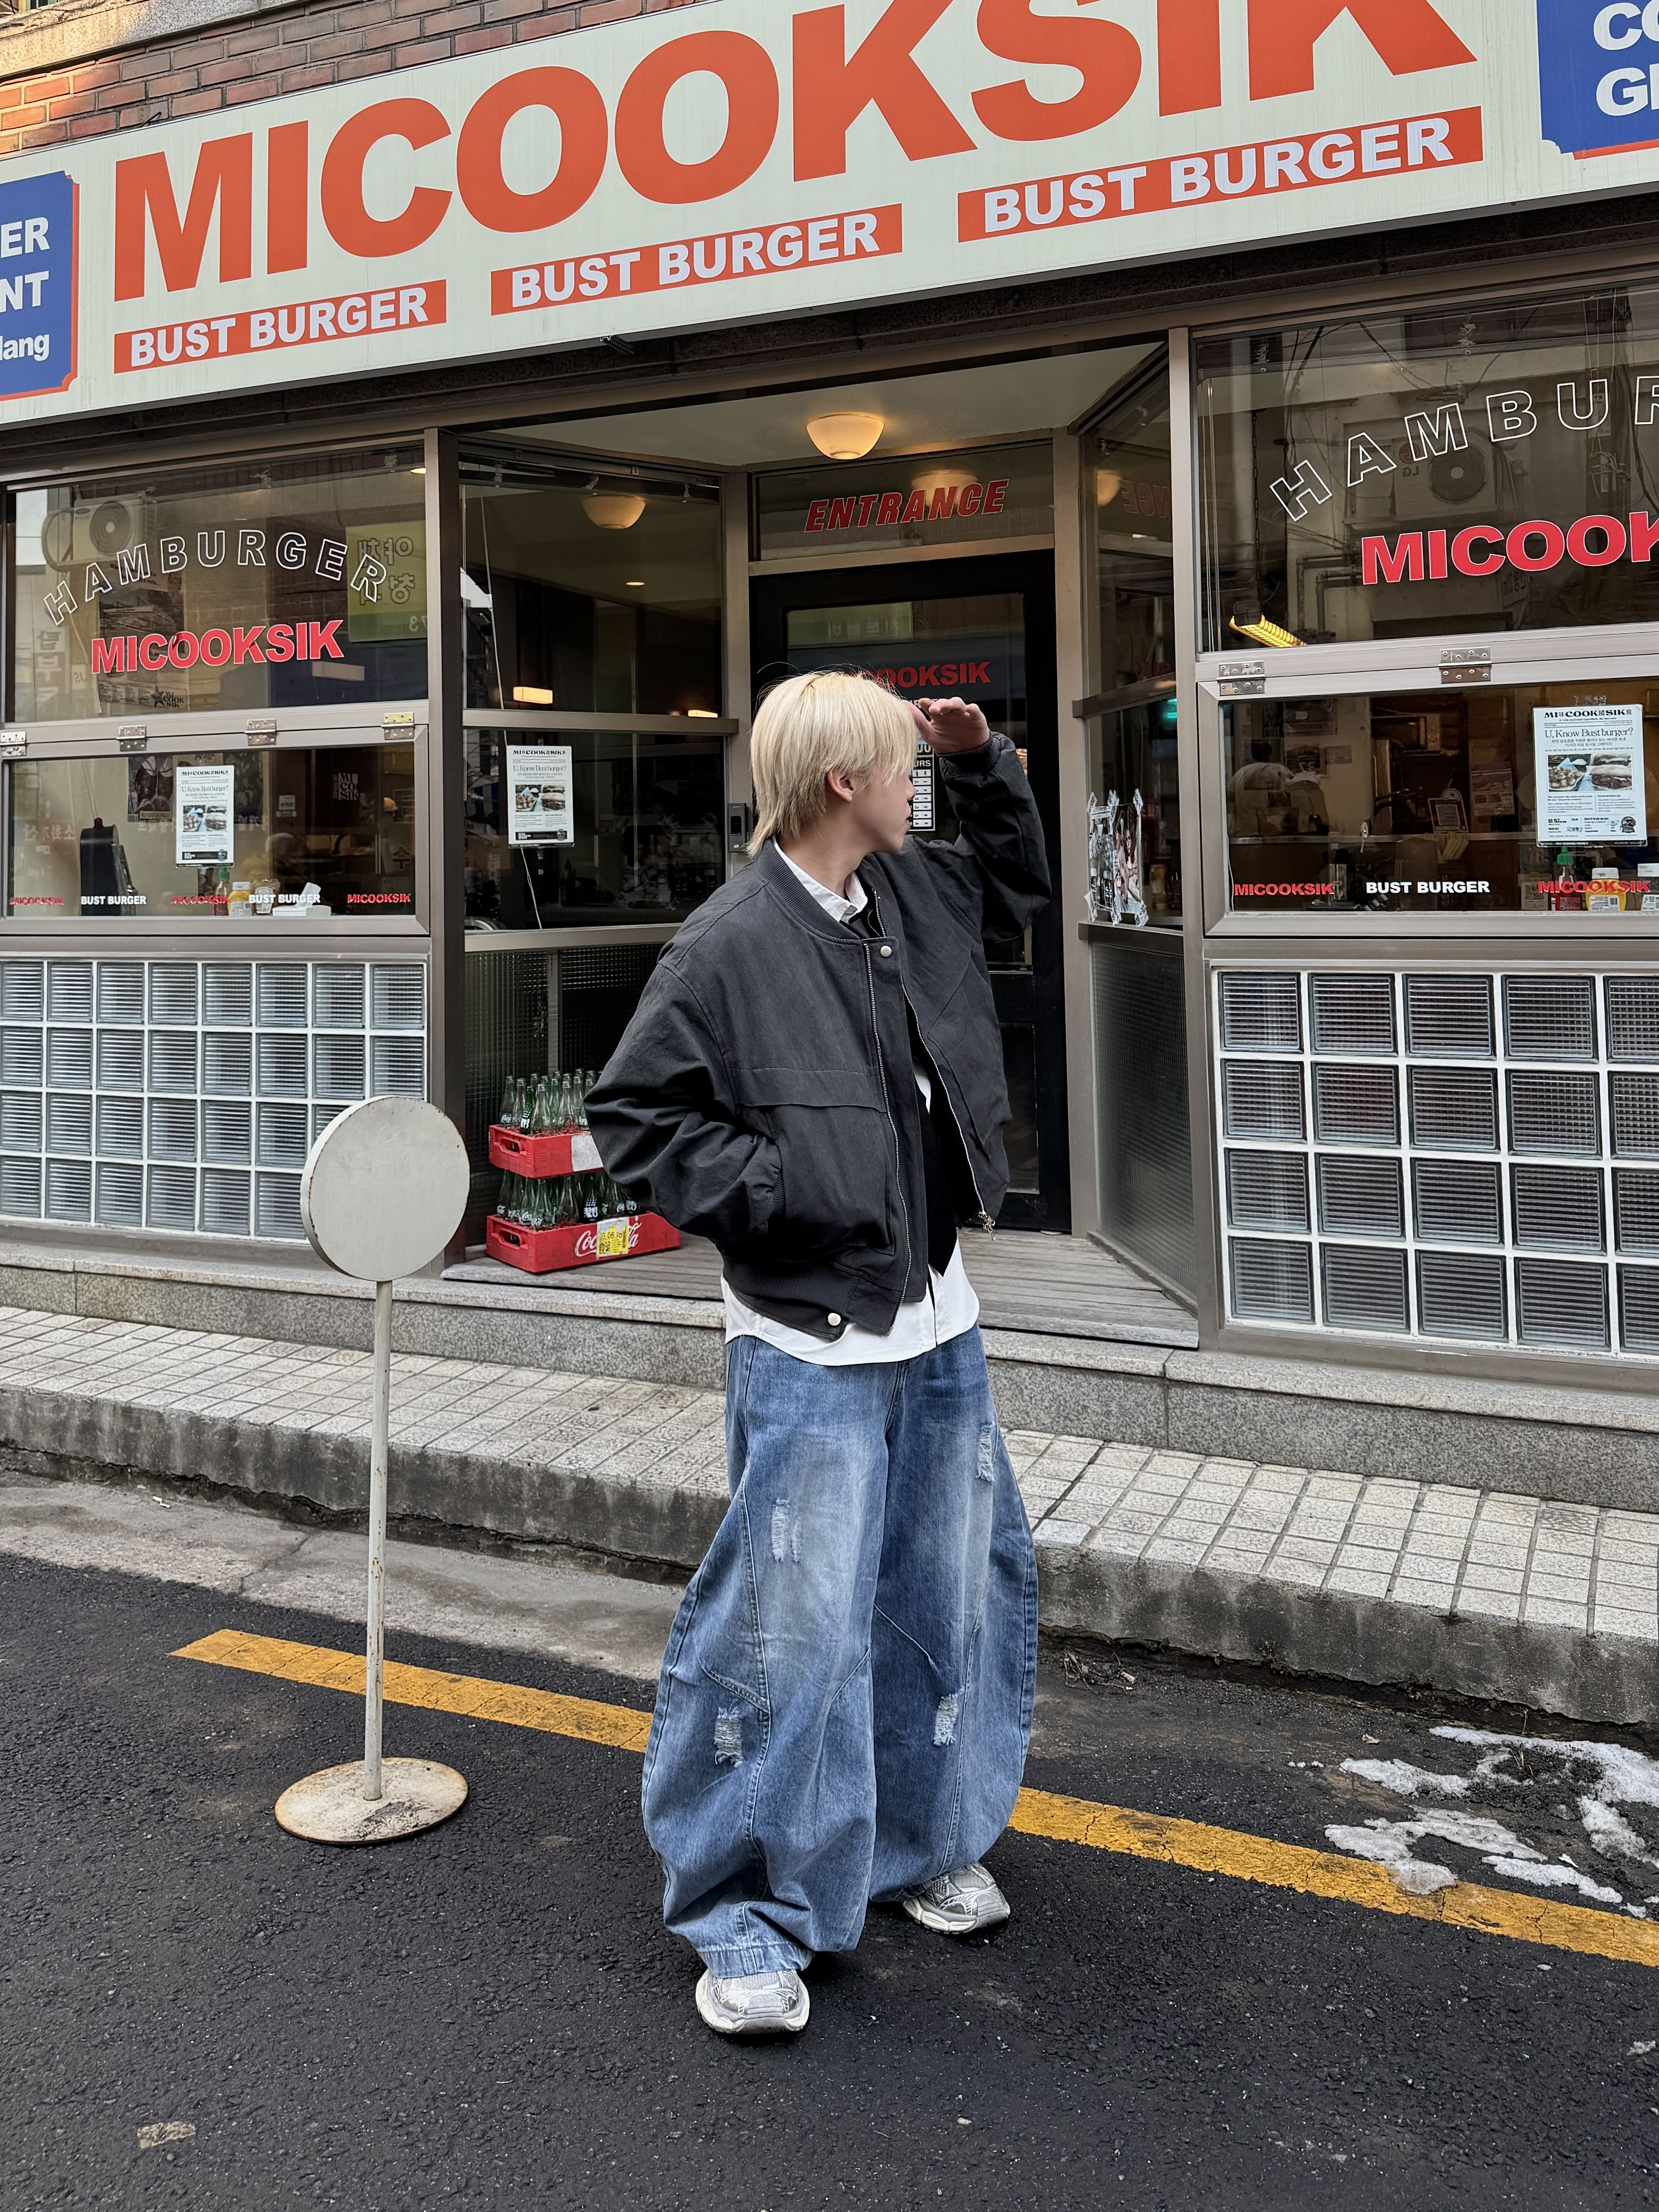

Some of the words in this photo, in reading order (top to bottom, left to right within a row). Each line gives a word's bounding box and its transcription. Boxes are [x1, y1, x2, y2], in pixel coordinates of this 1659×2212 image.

[1596, 63, 1659, 116] G
[984, 166, 1147, 233] BUST
[1171, 118, 1454, 203] BURGER
[511, 251, 641, 308] BUST
[658, 212, 881, 286] BURGER
[130, 317, 237, 367] BUST
[250, 287, 429, 349] BURGER
[804, 479, 1009, 532] ENTRANCE
[43, 529, 387, 626] HAMBURGER
[92, 620, 345, 675] MICOOKSIK
[1556, 730, 1580, 738] Know
[1581, 729, 1601, 737] Bust
[1602, 727, 1633, 737] burger?
[81, 895, 105, 905] BUST
[107, 895, 147, 905] BURGER
[248, 894, 276, 904] BUST
[278, 894, 321, 904] BURGER
[347, 893, 411, 904] MICOOKSIK
[1234, 882, 1334, 897] MICOOKSIK
[1366, 881, 1413, 894] BUST
[1417, 880, 1490, 894] BURGER
[1537, 879, 1651, 894] MICOOKSIK
